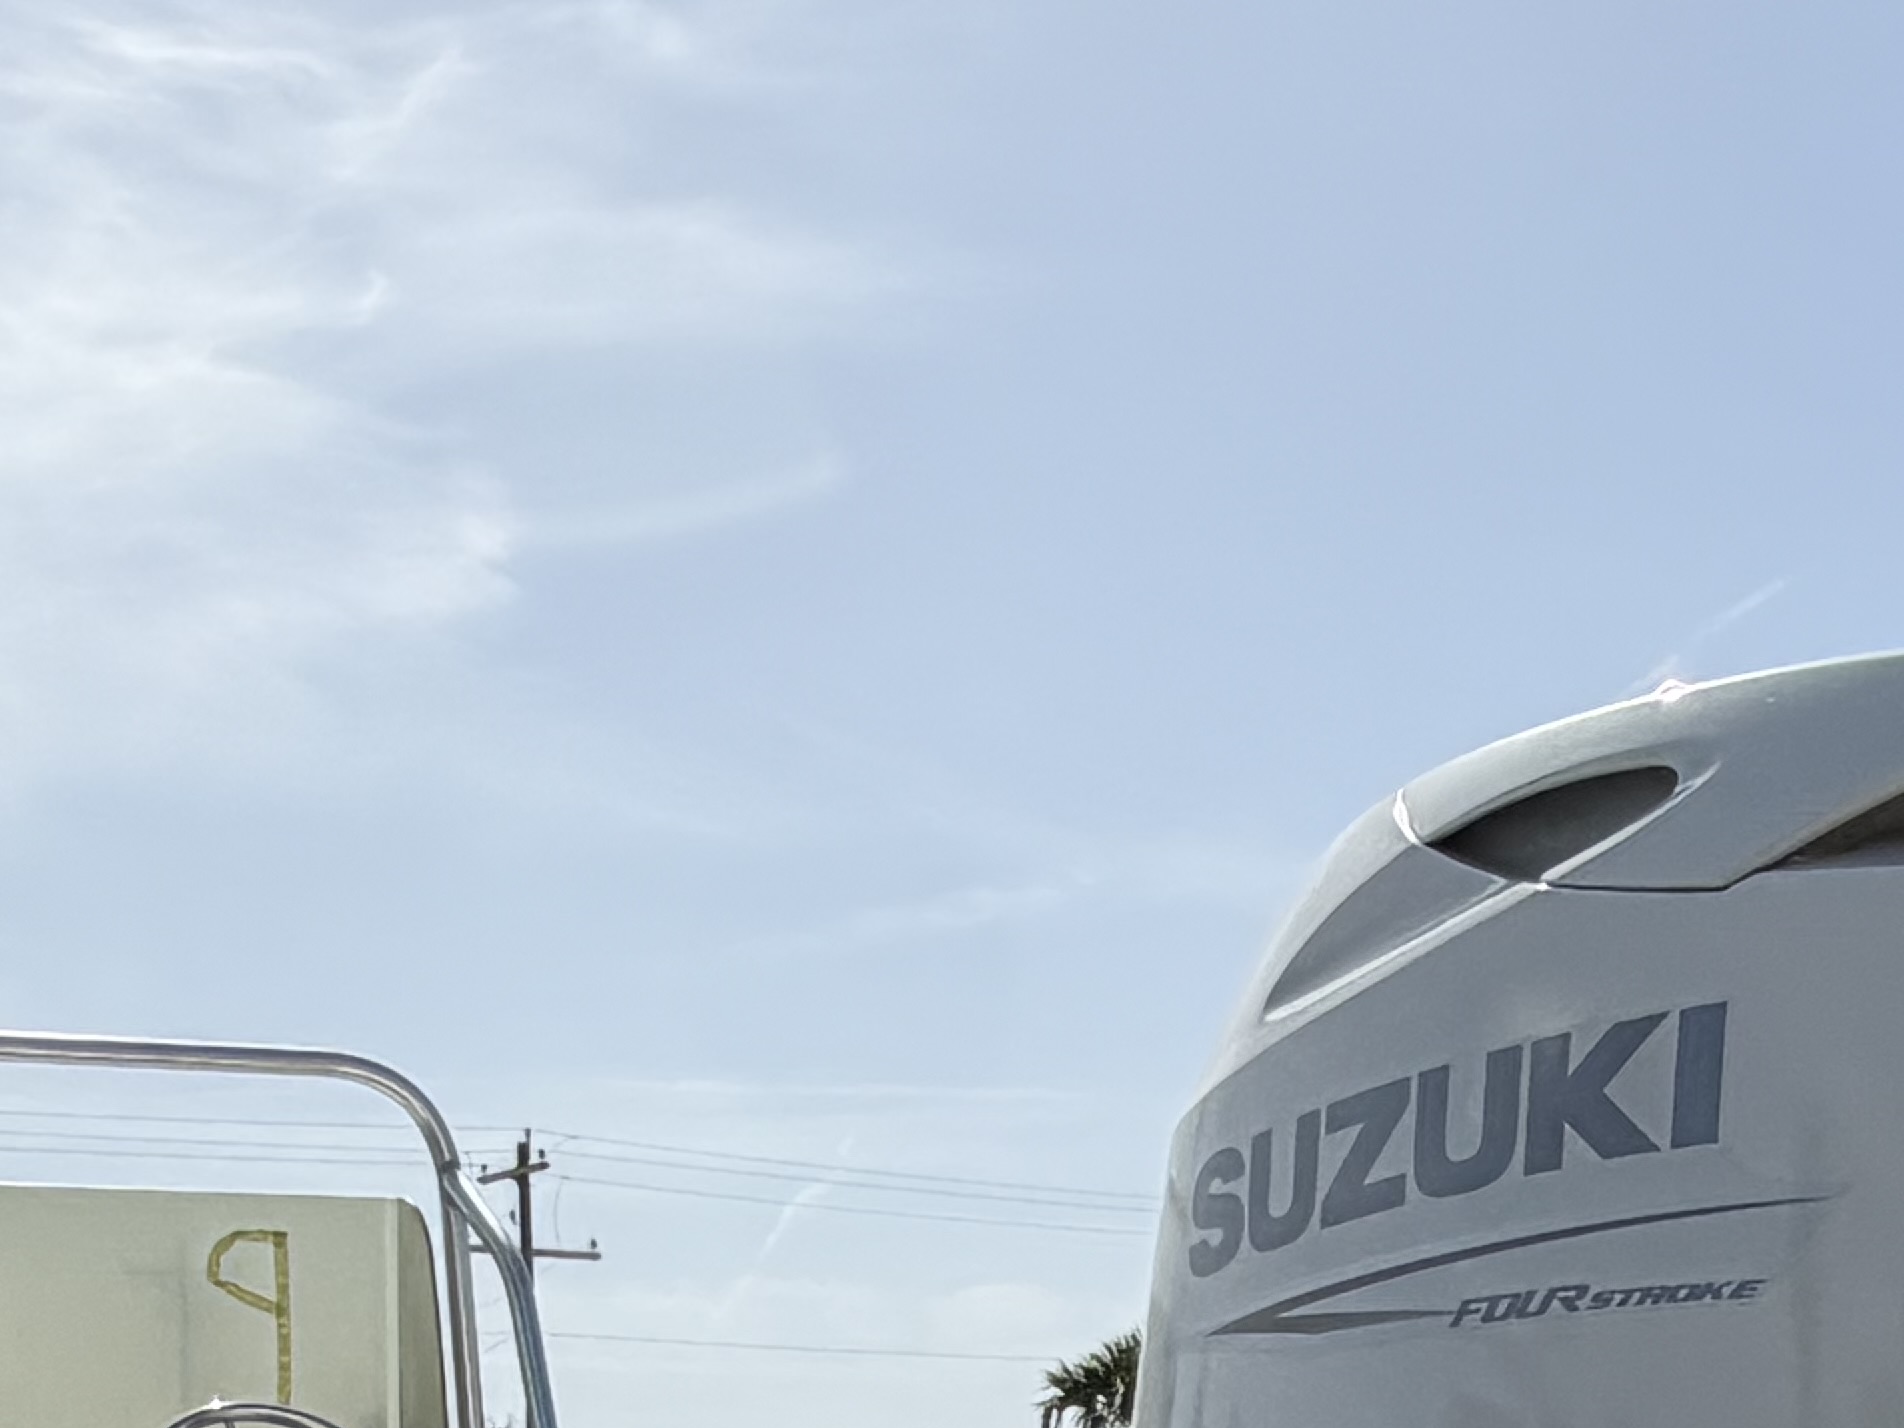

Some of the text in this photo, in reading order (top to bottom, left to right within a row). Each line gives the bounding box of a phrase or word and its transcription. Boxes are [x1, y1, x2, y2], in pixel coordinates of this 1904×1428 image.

[1188, 1001, 1728, 1278] SUZUKI
[1449, 1278, 1770, 1328] FOUR STROKE
